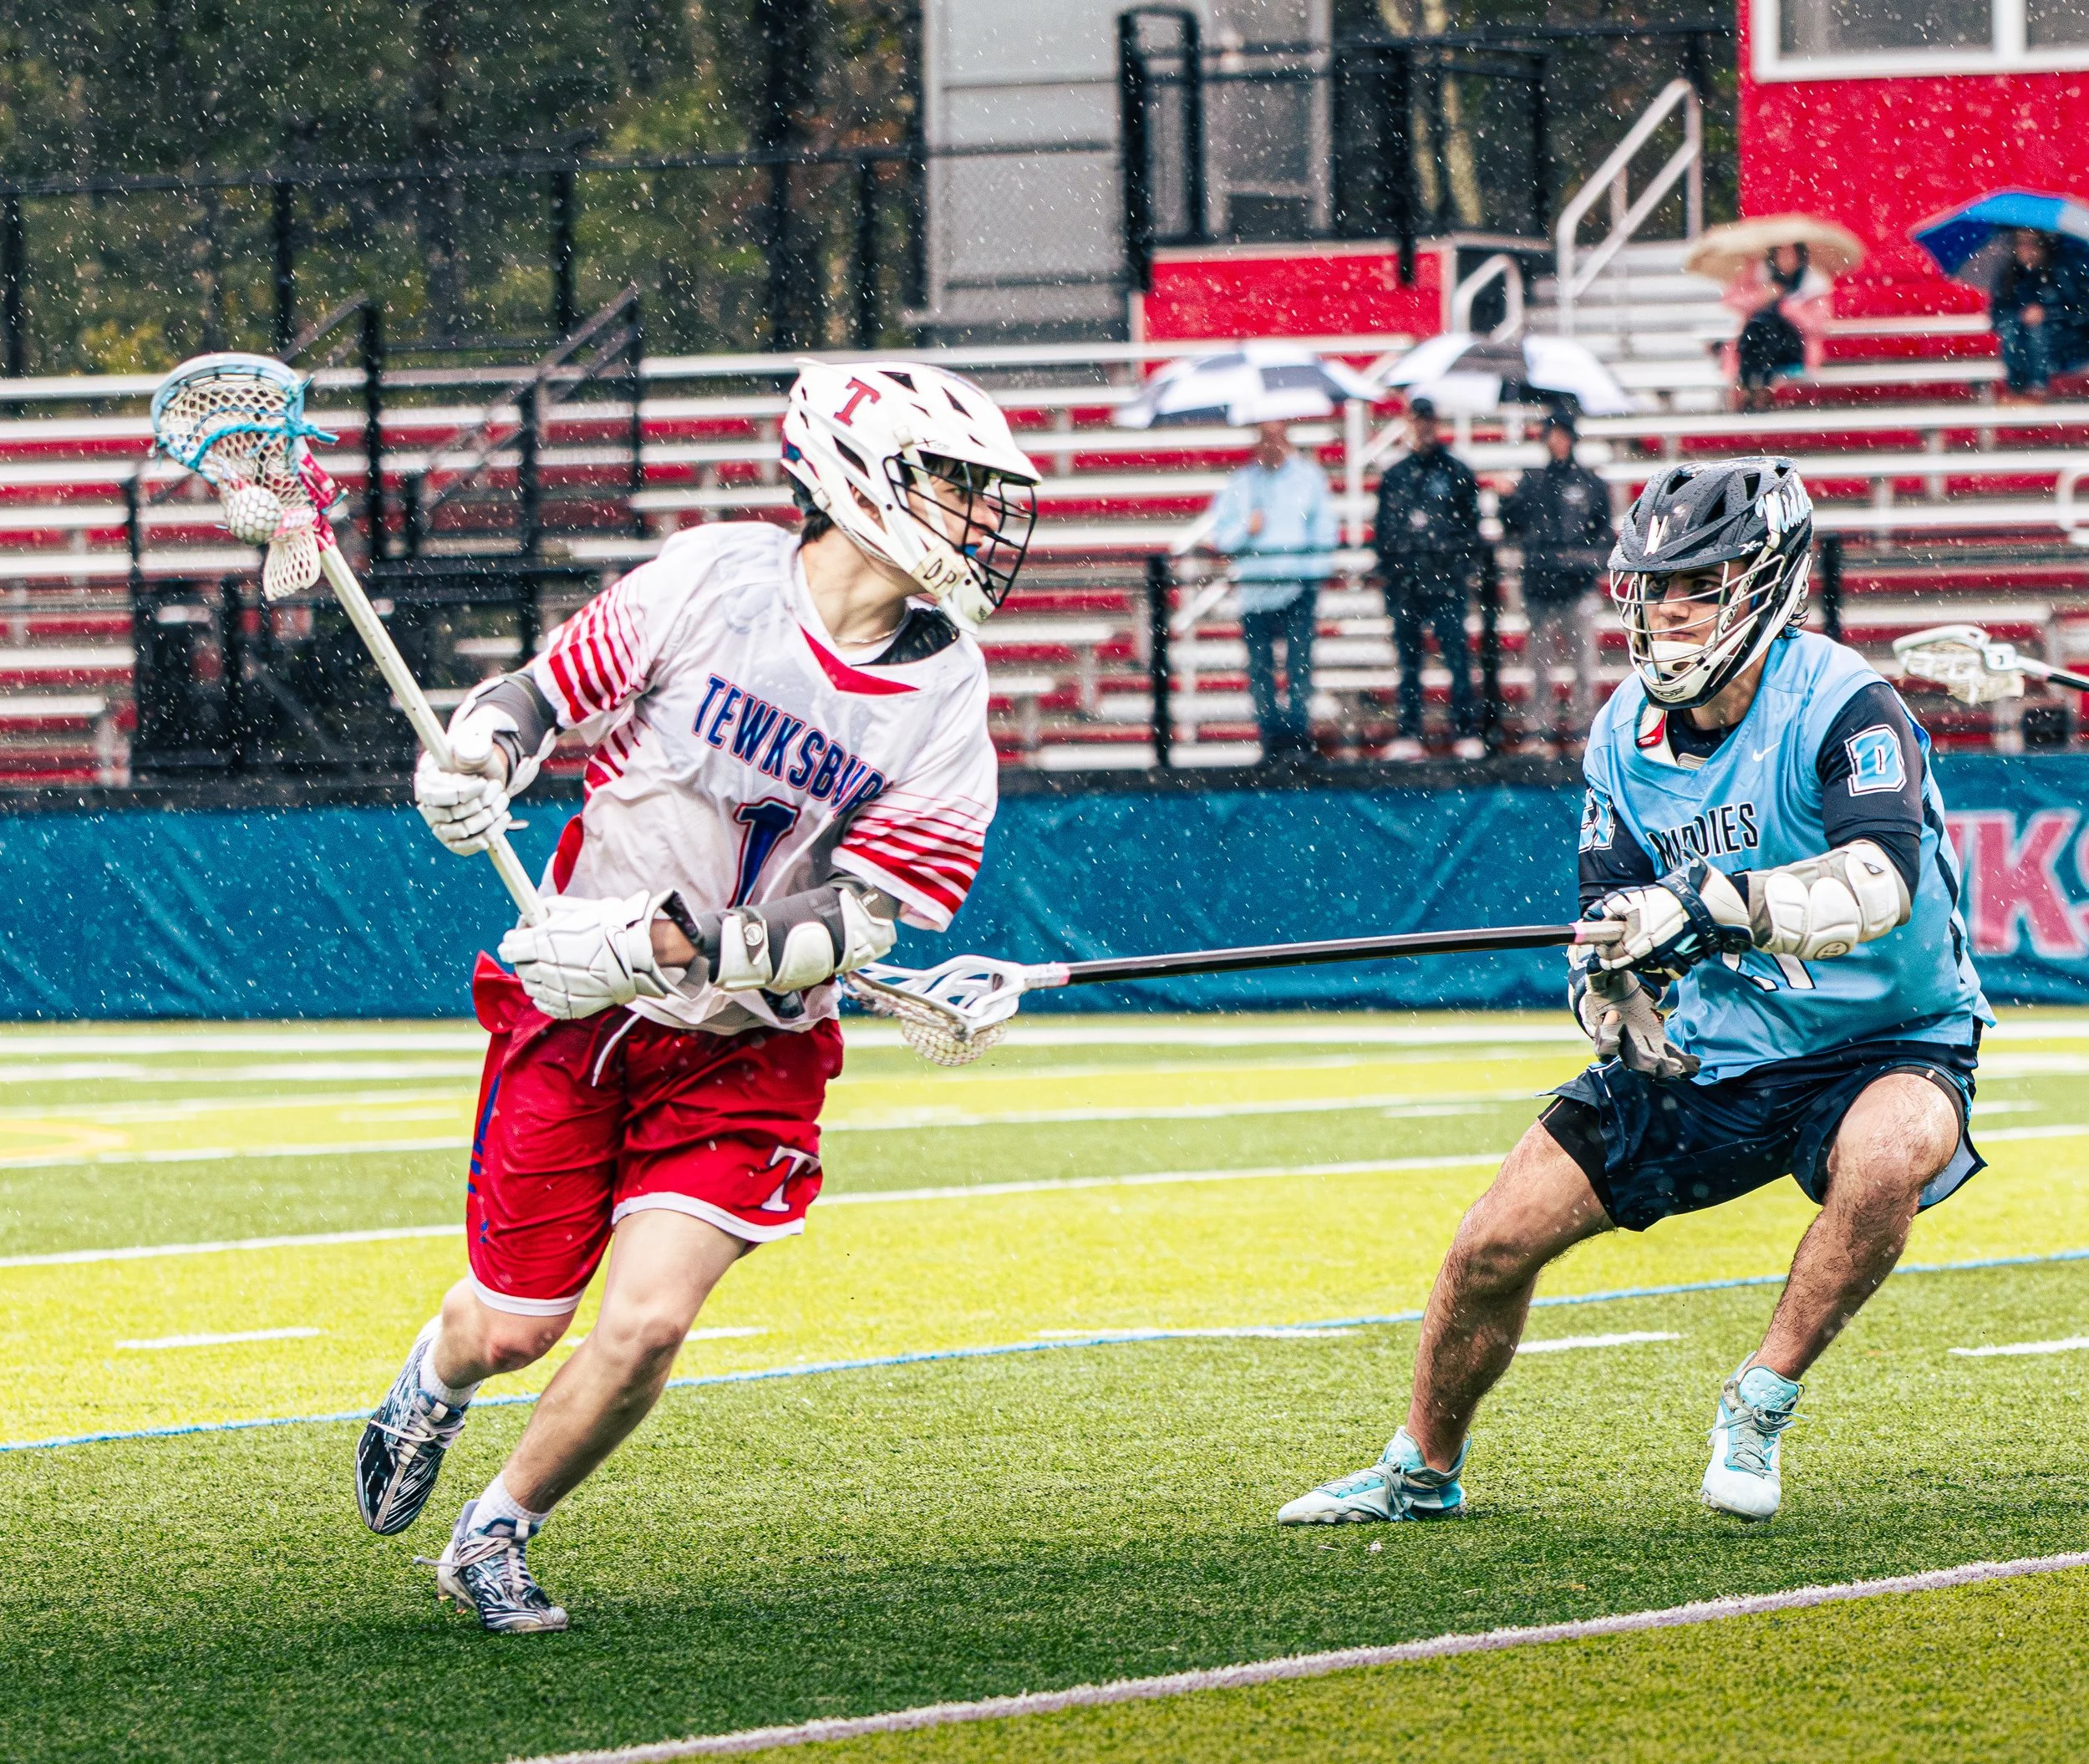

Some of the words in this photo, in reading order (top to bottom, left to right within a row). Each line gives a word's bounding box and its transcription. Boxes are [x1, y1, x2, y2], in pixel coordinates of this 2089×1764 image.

[834, 376, 882, 427] T
[1844, 724, 1907, 797] D
[727, 796, 801, 909] 1
[759, 1143, 821, 1213] T
